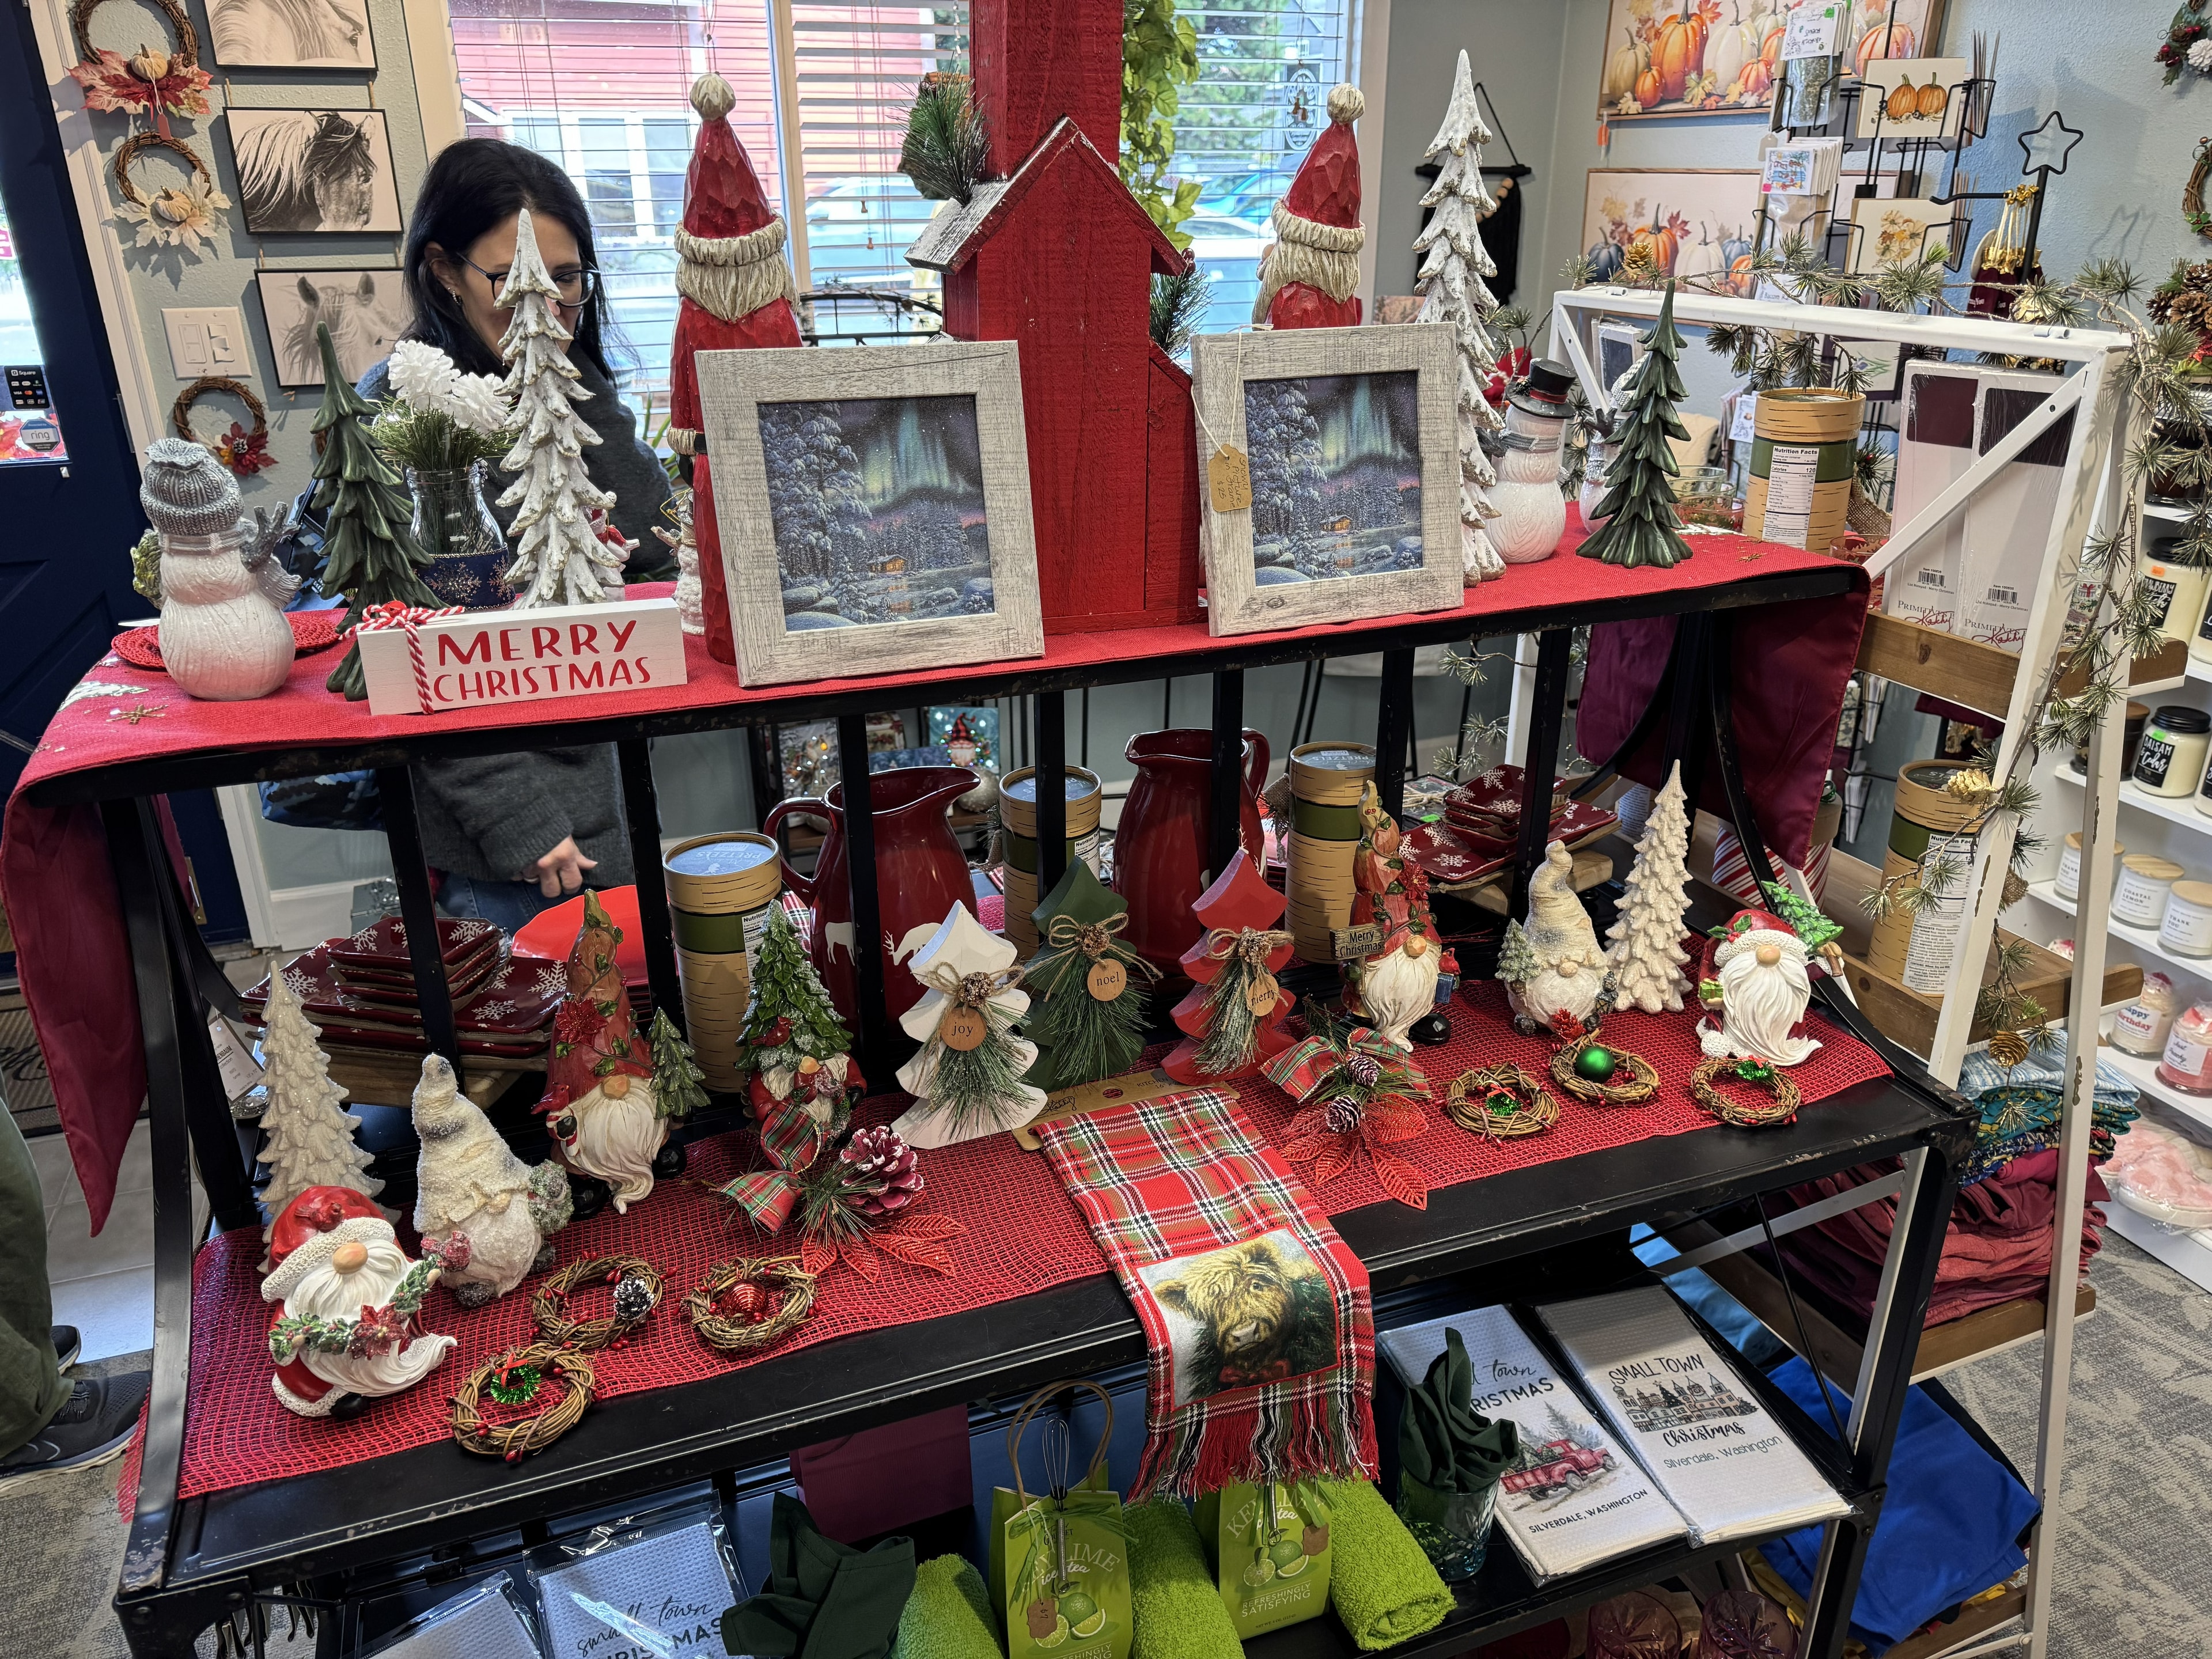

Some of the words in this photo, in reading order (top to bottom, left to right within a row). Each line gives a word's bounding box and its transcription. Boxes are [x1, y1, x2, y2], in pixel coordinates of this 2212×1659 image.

[31, 431, 50, 440] ring
[1225, 462, 1232, 470] in
[438, 620, 637, 666] MERRY
[433, 656, 652, 703] CHRISTMAS
[2143, 735, 2173, 756] BALSAM
[2141, 751, 2168, 772] Cedar
[696, 851, 762, 859] PRETZELS
[2122, 893, 2144, 904] LEMON
[2124, 888, 2152, 900] COASTAL
[1349, 931, 1374, 944] Merry
[1339, 941, 1382, 956] Christmas
[1096, 972, 1120, 987] noel
[951, 1022, 974, 1037] joy
[1137, 1077, 1168, 1088] KITCHEN
[1483, 1358, 1537, 1378] town
[1608, 1359, 1662, 1386] SMALL
[1657, 1354, 1705, 1374] TOWN
[1471, 1377, 1554, 1412] RISTMAS
[1663, 1420, 1747, 1448] Christmas
[1718, 1434, 1783, 1459] Washington
[1277, 1508, 1298, 1520] tea
[1528, 1512, 1586, 1533] SILVERDALE,
[1585, 1488, 1649, 1517] WASHINGTON
[1066, 1561, 1091, 1574] tea
[1241, 1589, 1311, 1618] SATISFYING
[1242, 1582, 1311, 1609] REFRESHINGLY
[650, 1596, 714, 1627] town
